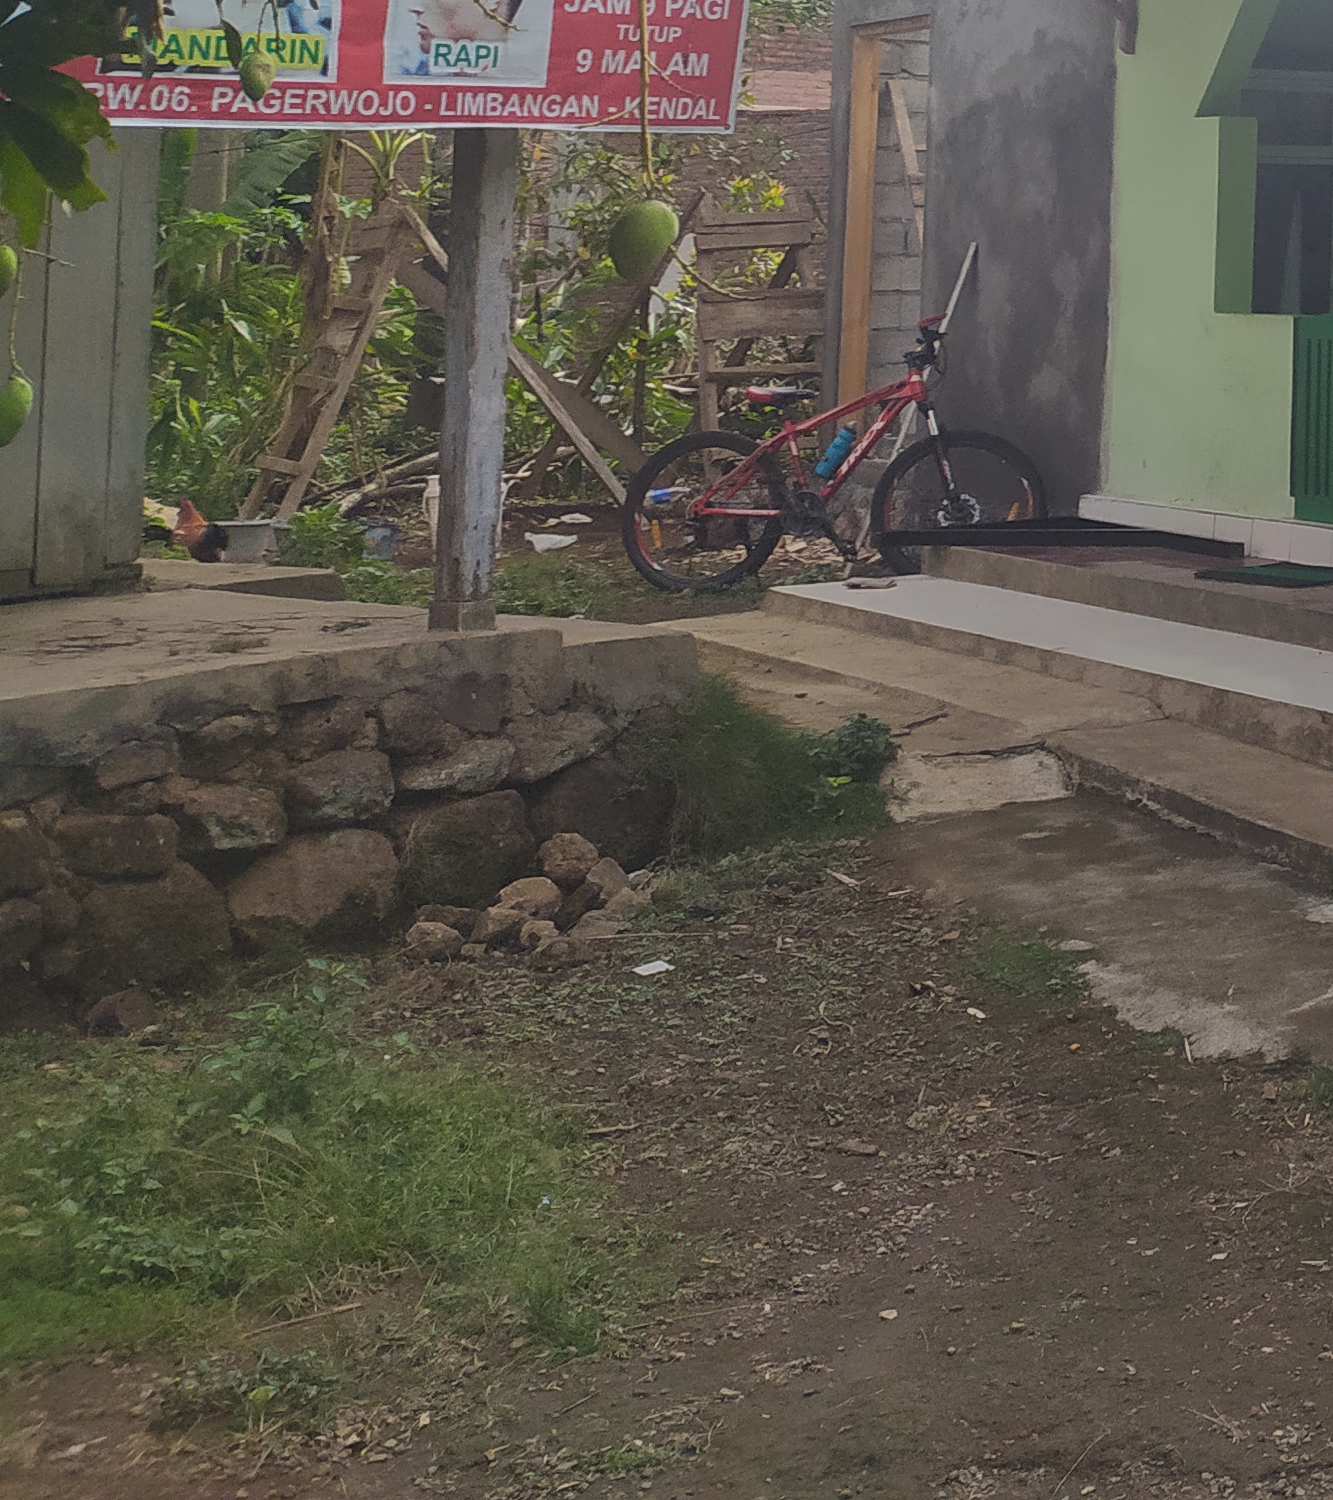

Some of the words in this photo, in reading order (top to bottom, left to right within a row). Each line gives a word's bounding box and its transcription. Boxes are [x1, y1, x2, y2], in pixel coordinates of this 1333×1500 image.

[617, 24, 682, 42] TUTUP
[433, 43, 499, 68] RAPI
[576, 49, 593, 73] 9
[601, 49, 710, 76] MALAM
[211, 86, 416, 116] PAGERWOJO
[439, 92, 600, 118] LIMBANGAN
[624, 97, 721, 121] KENDAL
